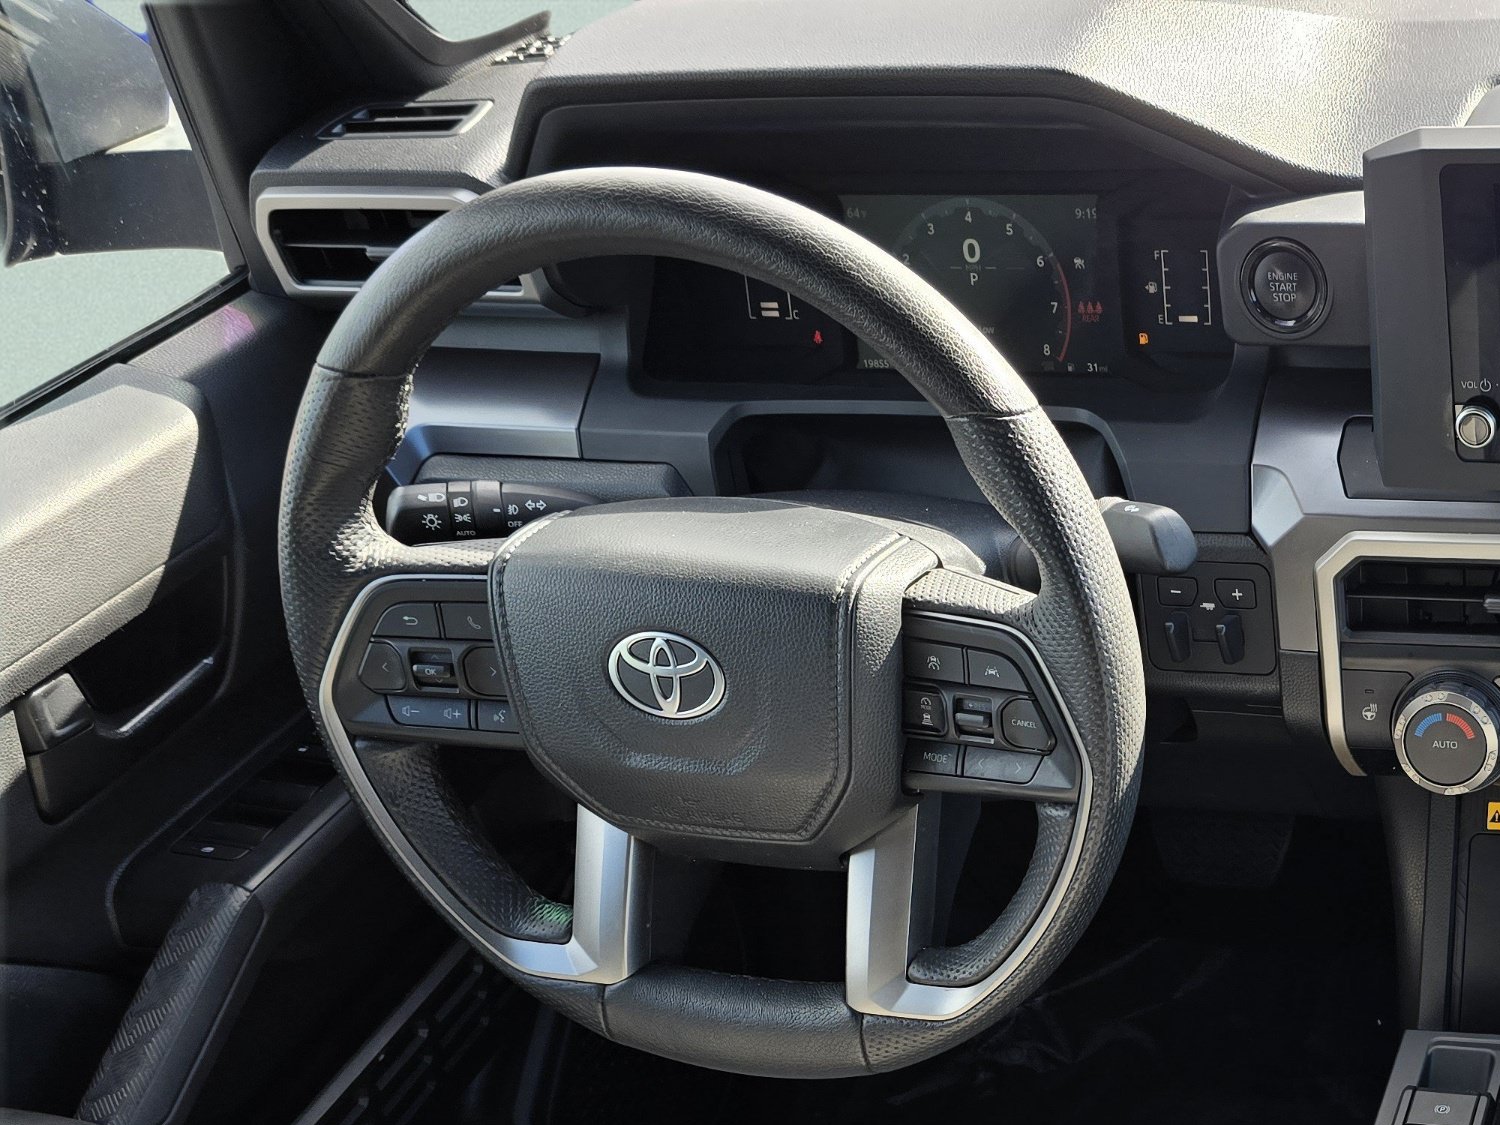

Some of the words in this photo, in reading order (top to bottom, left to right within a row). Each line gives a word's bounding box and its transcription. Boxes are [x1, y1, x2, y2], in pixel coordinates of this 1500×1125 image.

[965, 211, 973, 223] 4
[927, 223, 935, 235] 3
[1006, 224, 1014, 236] 5
[962, 238, 981, 263] 0
[1037, 256, 1045, 267] 6
[970, 273, 979, 286] P
[1268, 272, 1298, 281] ENGINE
[1269, 282, 1297, 292] START
[1273, 293, 1297, 303] STOP
[1051, 302, 1058, 314] 7
[1043, 344, 1051, 356] 8
[1087, 363, 1099, 373] 31
[1461, 380, 1478, 389] VOL
[1012, 719, 1037, 729] CANCEL
[1432, 741, 1458, 749] AUTO
[923, 752, 948, 764] MODE
